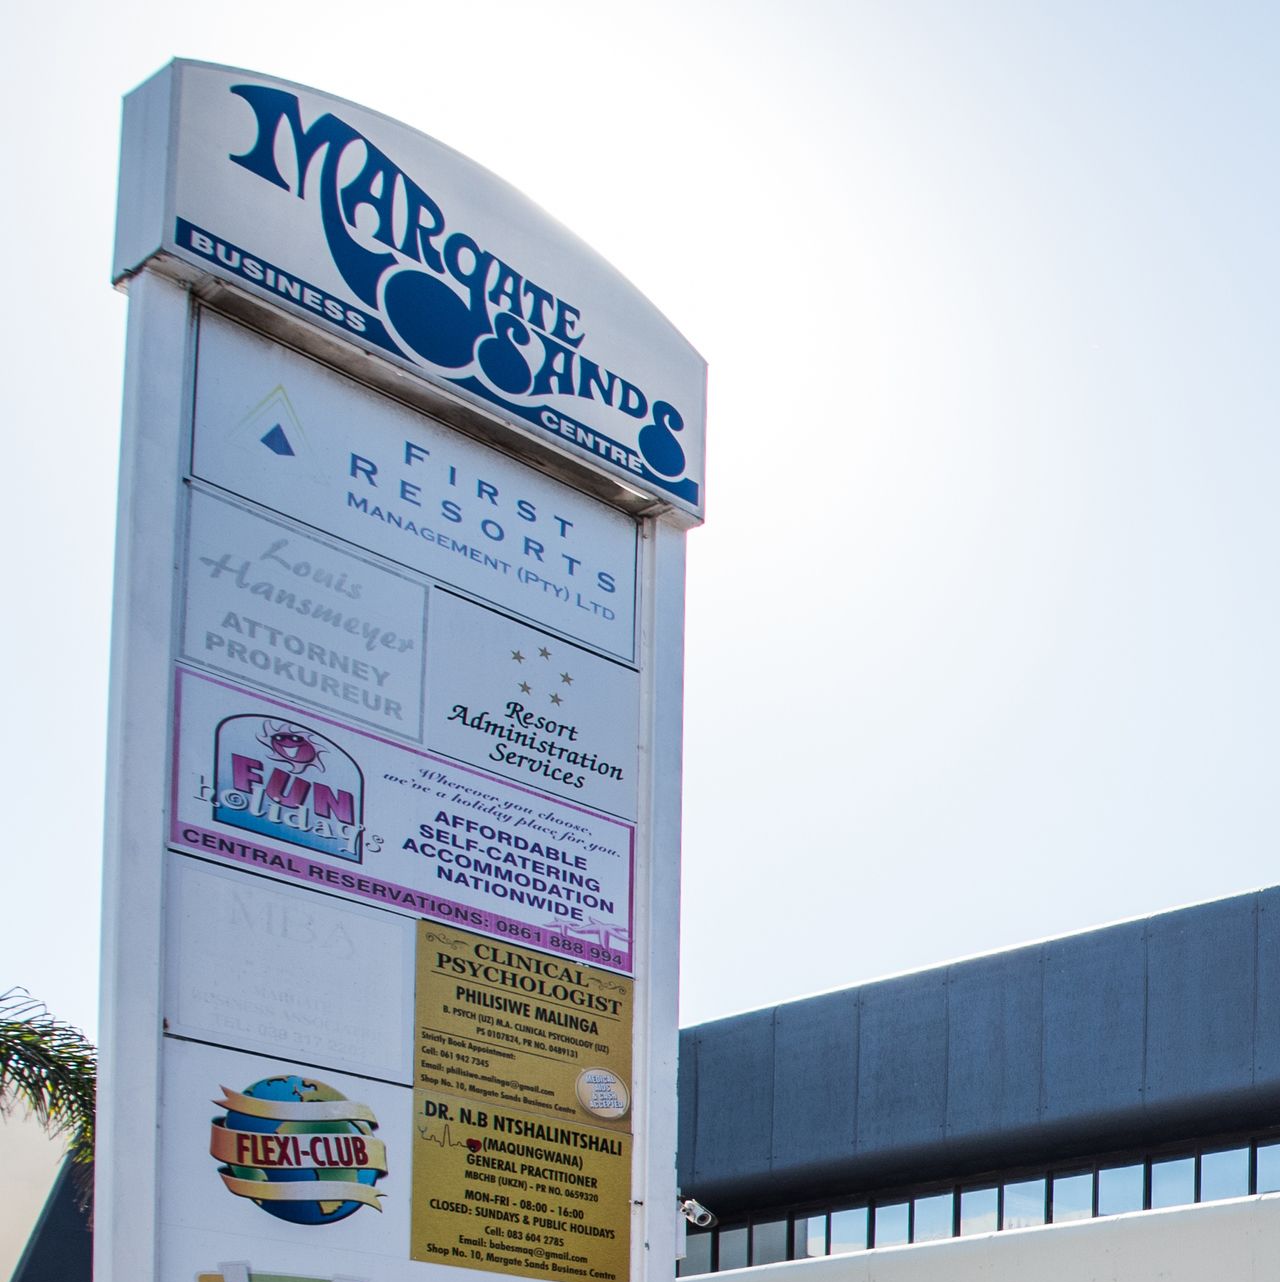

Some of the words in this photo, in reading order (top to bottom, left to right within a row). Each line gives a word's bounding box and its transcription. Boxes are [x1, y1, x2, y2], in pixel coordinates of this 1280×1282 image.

[190, 229, 366, 333] BUSINESS
[477, 311, 686, 478] SANDS
[539, 412, 645, 475] CENTRE
[404, 440, 574, 538] FIRST
[350, 452, 616, 594] RESORTS
[260, 539, 364, 600] Louis
[347, 491, 511, 575] MANAGEMENT
[517, 567, 570, 602] (PTY)
[577, 593, 615, 621] LTD
[198, 554, 414, 653] Hansmeyer
[205, 631, 403, 720] PROKUREUR
[221, 611, 390, 687] ATTORNEY
[447, 704, 624, 780] Administration
[504, 701, 578, 741] Resort
[231, 753, 355, 827] FUN
[489, 743, 586, 789] Services
[193, 772, 385, 857] holidays
[383, 772, 431, 794] we've
[436, 790, 447, 799] a
[451, 791, 512, 823] holiday
[514, 817, 556, 841] place
[553, 831, 585, 852] for
[583, 841, 621, 858] you.
[418, 767, 499, 801] Wherever
[498, 799, 533, 815] you
[538, 812, 592, 836] choose,
[419, 824, 601, 893] SELF-CATERING
[434, 810, 588, 871] AFFORDABLE
[182, 828, 302, 874] CENTRAL
[308, 863, 490, 929] RESERVATIONS:
[496, 919, 542, 943] 0861
[550, 935, 584, 956] 888
[589, 947, 622, 967] 994
[402, 838, 615, 914] ACCOMMODATION
[437, 865, 584, 922] NATIONWIDE
[436, 952, 623, 1016] PSYCHOLOGIST
[473, 943, 589, 988] CLINICAL
[452, 1006, 477, 1021] PSYCH
[478, 1012, 495, 1027] (UZ)
[514, 1023, 546, 1038] CLINICAL
[548, 1031, 593, 1050] PSYCHOLOGY
[594, 1042, 610, 1055] (UZ)
[456, 985, 530, 1018] PHILISIWE
[534, 1006, 599, 1036] MALINGA
[420, 1059, 445, 1073] Email:
[421, 1031, 446, 1046] Strictly
[447, 1036, 466, 1049] Book
[421, 1045, 439, 1056] Cell:
[440, 1049, 454, 1060] 061
[455, 1053, 470, 1064] 942
[471, 1056, 490, 1068] 7345
[522, 1038, 533, 1048] PR
[420, 1074, 439, 1086] Shop
[469, 1083, 499, 1099] Margate
[500, 1090, 521, 1103] Sands
[523, 1096, 553, 1110] Business
[554, 1103, 577, 1115] Centre
[236, 1133, 369, 1168] FLEXI-CLUB
[424, 1100, 454, 1122] DR.
[460, 1107, 488, 1128] N.B
[494, 1116, 622, 1156] NTSHALINTSHALI
[483, 1137, 583, 1170] (MAQUNGWANA)
[464, 1170, 496, 1184] MBCHB
[499, 1176, 528, 1191] (UKZN)
[536, 1184, 547, 1194] PR
[548, 1186, 563, 1197] NO.
[565, 1189, 599, 1203] 0659320
[466, 1154, 518, 1174] GENERAL
[520, 1164, 598, 1189] PRACTITIONER
[429, 1199, 472, 1215] CLOSED:
[475, 1208, 520, 1225] SUNDAYS
[523, 1214, 530, 1225] &
[533, 1218, 567, 1232] PUBLIC
[570, 1224, 615, 1239] HOLIDAYS
[465, 1189, 510, 1206] MON-FRI
[520, 1199, 548, 1213] 08:00
[557, 1206, 584, 1219] 16:00
[427, 1243, 450, 1256] Shop
[452, 1247, 468, 1258] No.
[470, 1250, 484, 1262] 10,
[486, 1254, 522, 1269] Margate
[524, 1259, 549, 1271] Sands
[551, 1263, 588, 1276] Business
[589, 1269, 616, 1280] Centre
[459, 1235, 487, 1248] Email:
[484, 1226, 504, 1237] Cell:
[507, 1229, 523, 1240] 083
[525, 1232, 541, 1243] 604
[544, 1235, 564, 1247] 2785
